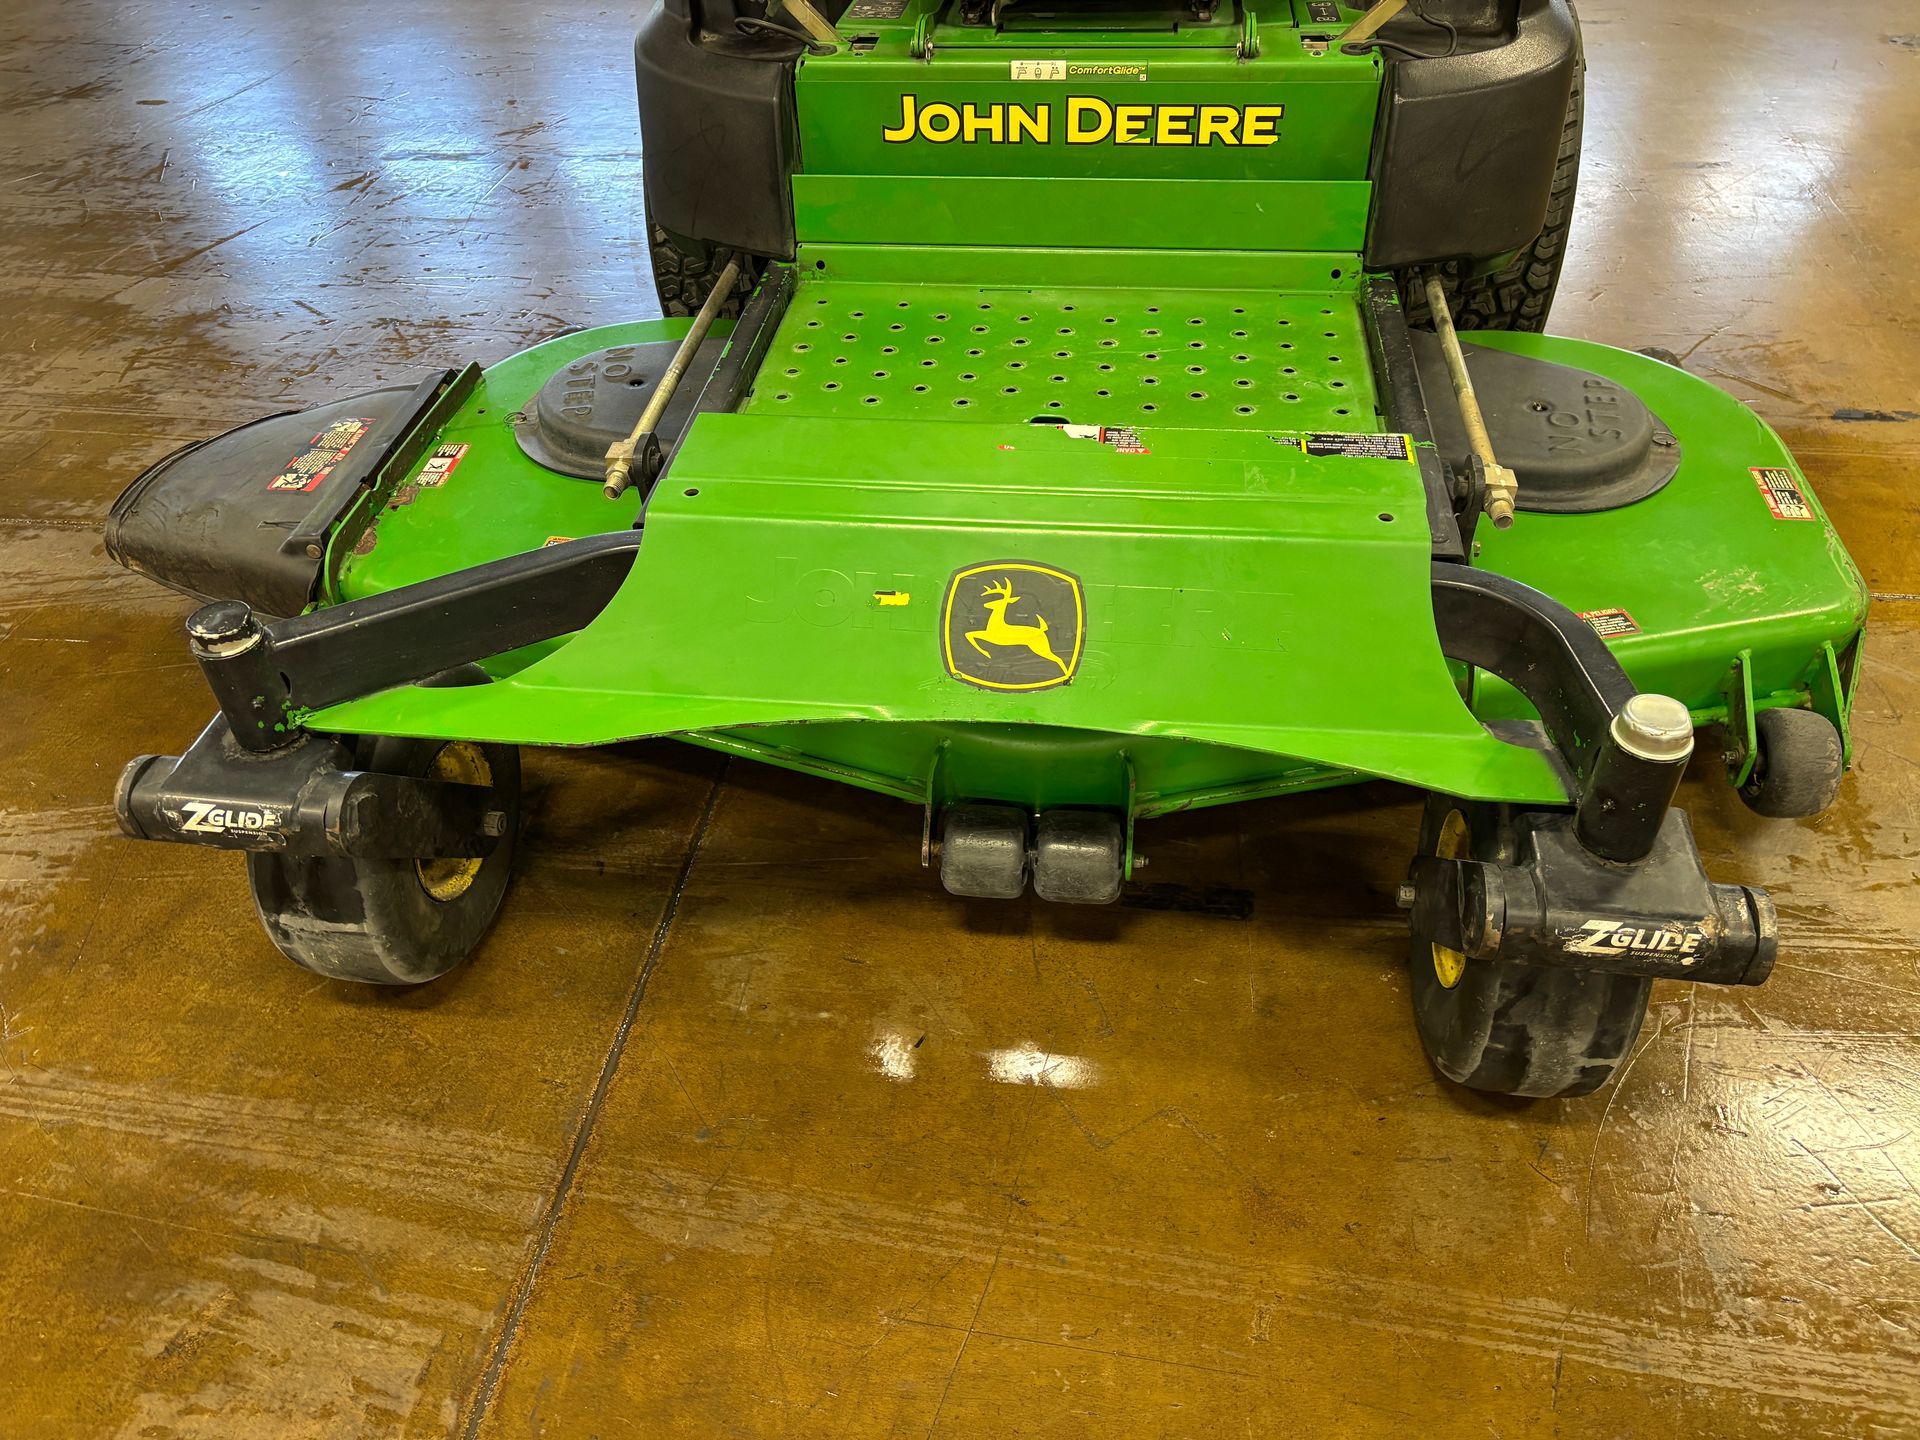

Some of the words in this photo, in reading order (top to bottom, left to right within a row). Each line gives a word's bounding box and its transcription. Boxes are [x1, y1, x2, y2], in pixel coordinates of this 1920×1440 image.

[883, 93, 1052, 145] JOHN
[1065, 94, 1285, 147] DEERE
[601, 347, 635, 378] NO
[1547, 411, 1584, 454] NO
[1583, 379, 1622, 440] STEP
